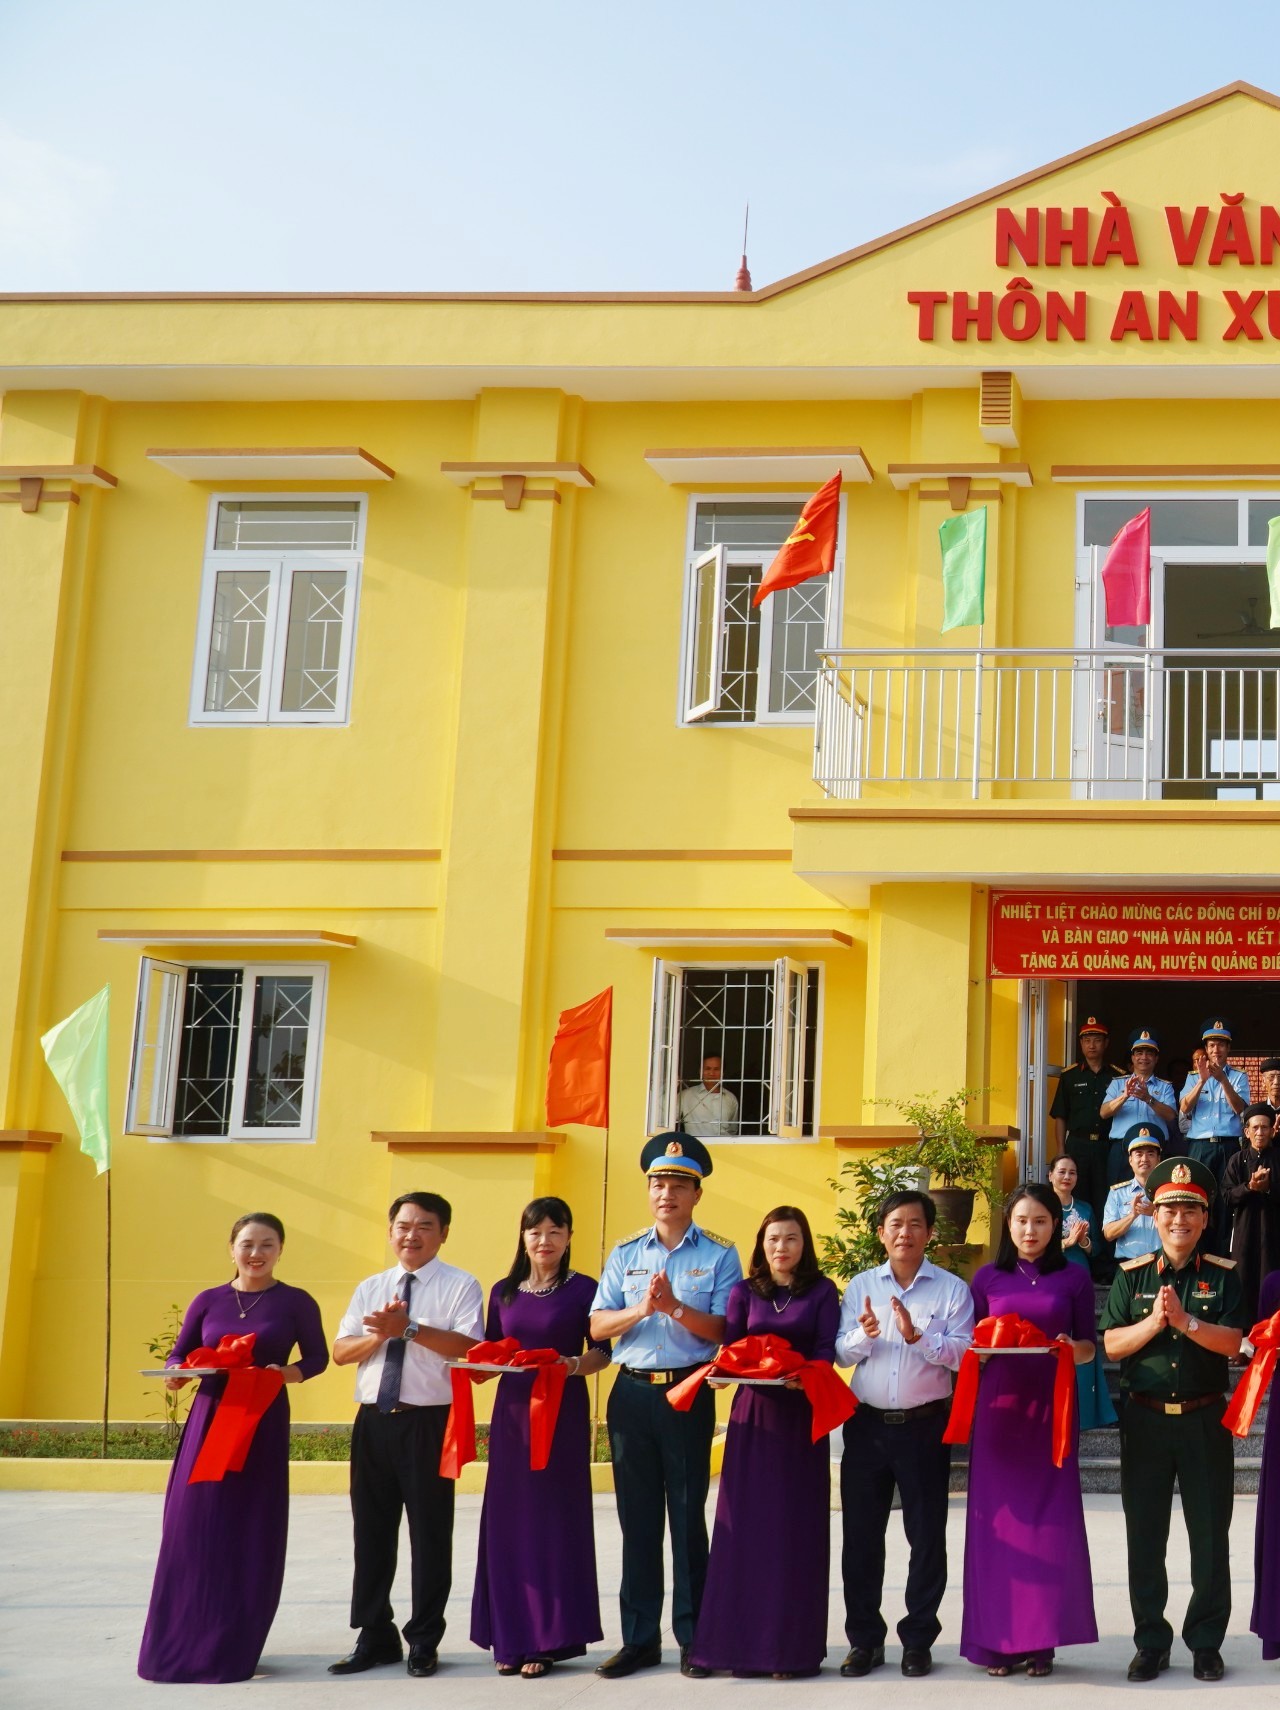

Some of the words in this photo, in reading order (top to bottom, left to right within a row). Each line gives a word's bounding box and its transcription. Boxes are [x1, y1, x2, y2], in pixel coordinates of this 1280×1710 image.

[995, 191, 1139, 267] NHÀ
[907, 276, 1087, 341] THÔN
[1110, 290, 1198, 341] AN
[1001, 902, 1041, 922] NHIỆT
[1046, 902, 1076, 922] LIỆT
[1080, 902, 1118, 920] CHÀO
[1122, 902, 1162, 920] MỪNG
[1166, 902, 1193, 921] CÁC
[1197, 901, 1235, 921] ĐỒNG
[1239, 903, 1263, 921] CHÍ
[1042, 926, 1060, 944] VÀ
[1064, 926, 1093, 944] BÀN
[1096, 930, 1129, 945] GIAO
[1173, 927, 1201, 945] VĂN
[1205, 927, 1234, 945] HÓA
[1247, 926, 1275, 945] KẾT
[1020, 951, 1057, 972] TẶNG
[1060, 951, 1079, 969] XÃ
[1083, 950, 1130, 972] QUẢNG
[1133, 955, 1156, 972] AN,
[1160, 951, 1207, 973] HUYỆN
[1211, 950, 1258, 973] QUẢNG
